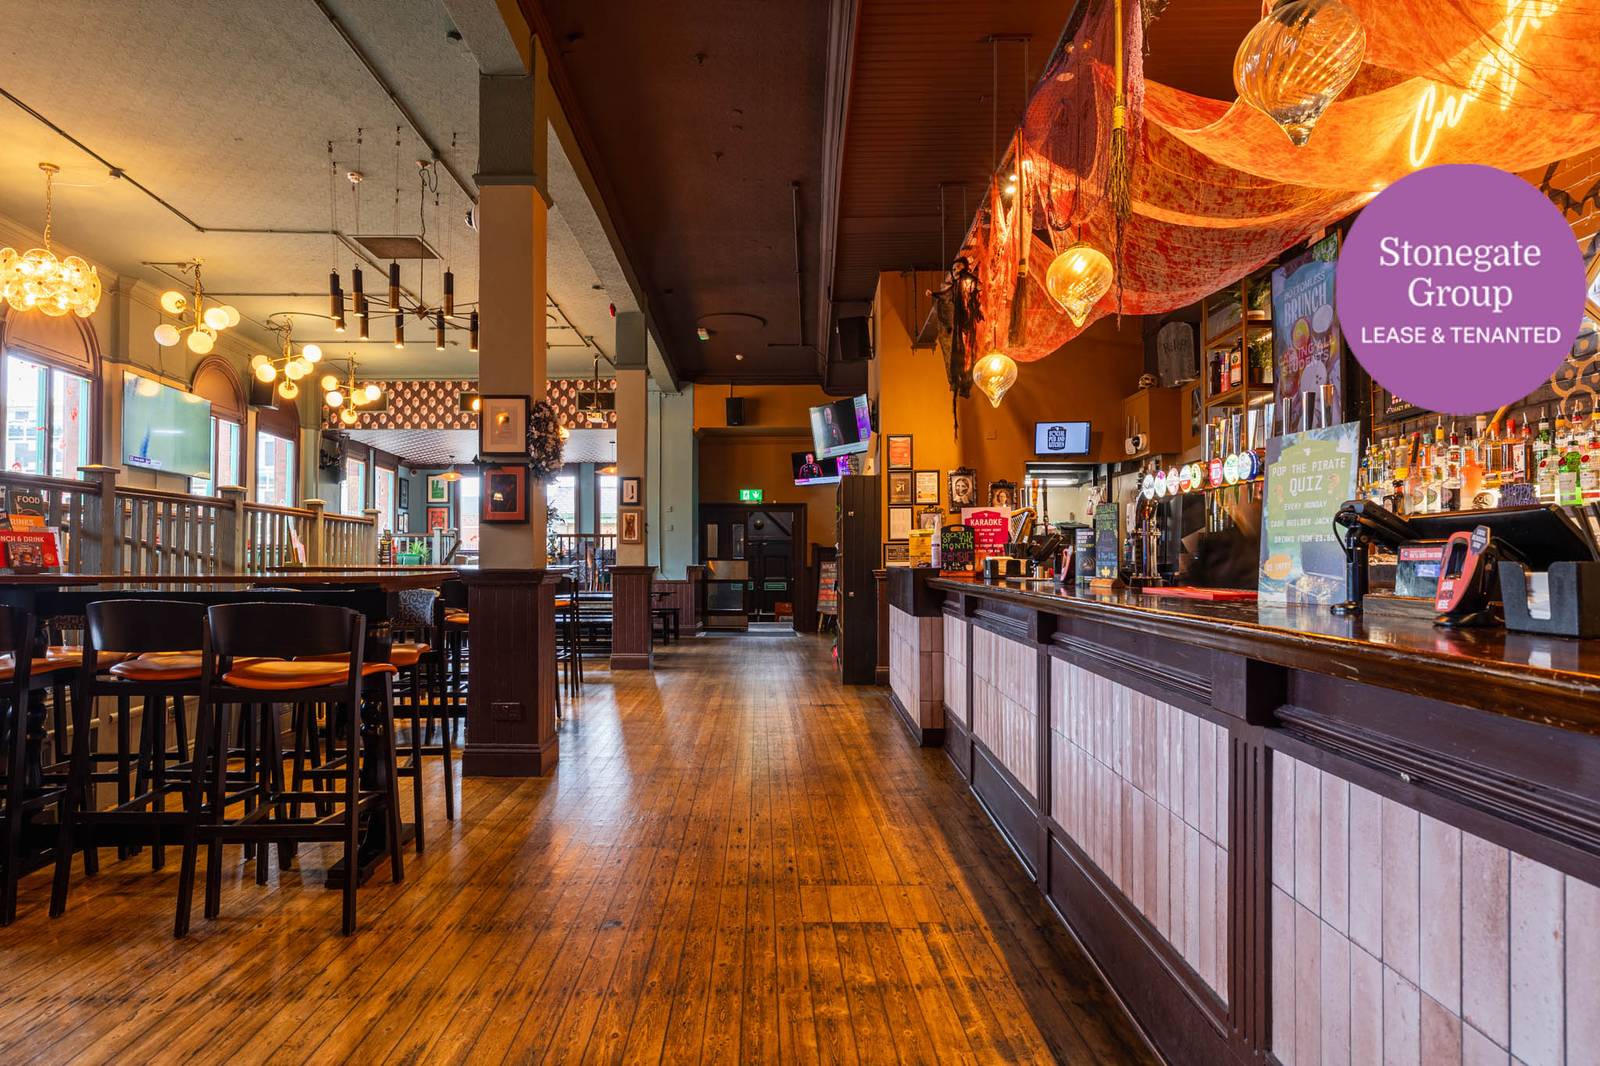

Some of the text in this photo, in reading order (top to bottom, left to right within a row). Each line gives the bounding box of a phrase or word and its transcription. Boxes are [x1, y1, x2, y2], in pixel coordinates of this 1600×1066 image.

[1284, 281, 1327, 327] BRUNCH
[1292, 463, 1307, 474] THE
[1312, 457, 1346, 472] PIRATE
[1289, 475, 1323, 496] QUIZ
[16, 495, 41, 504] FOOD
[1304, 499, 1328, 509] MONDAY
[970, 518, 1003, 526] KARAOKE
